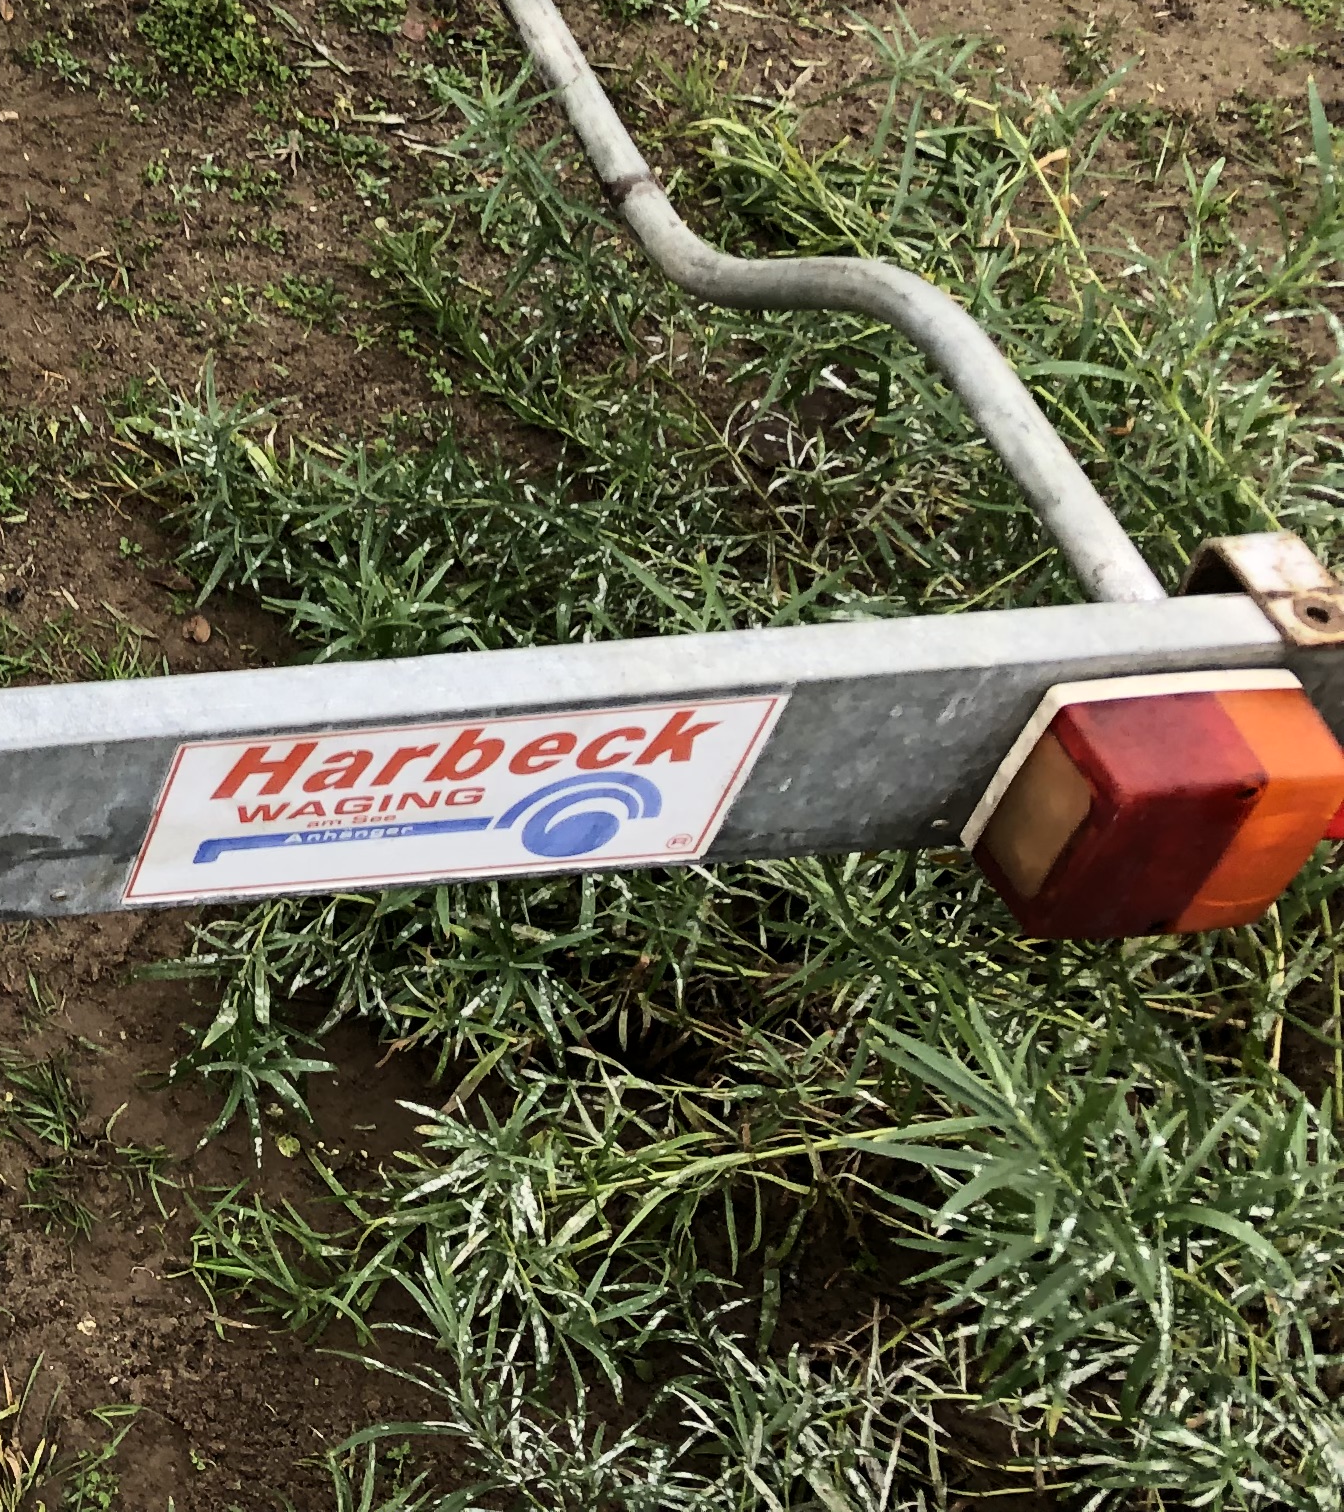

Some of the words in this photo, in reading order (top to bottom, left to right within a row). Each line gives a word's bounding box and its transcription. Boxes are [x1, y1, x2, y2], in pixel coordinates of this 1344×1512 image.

[211, 710, 722, 800] Harbeck
[236, 787, 486, 823] WAGING
[306, 818, 342, 829] am
[351, 814, 397, 824] See
